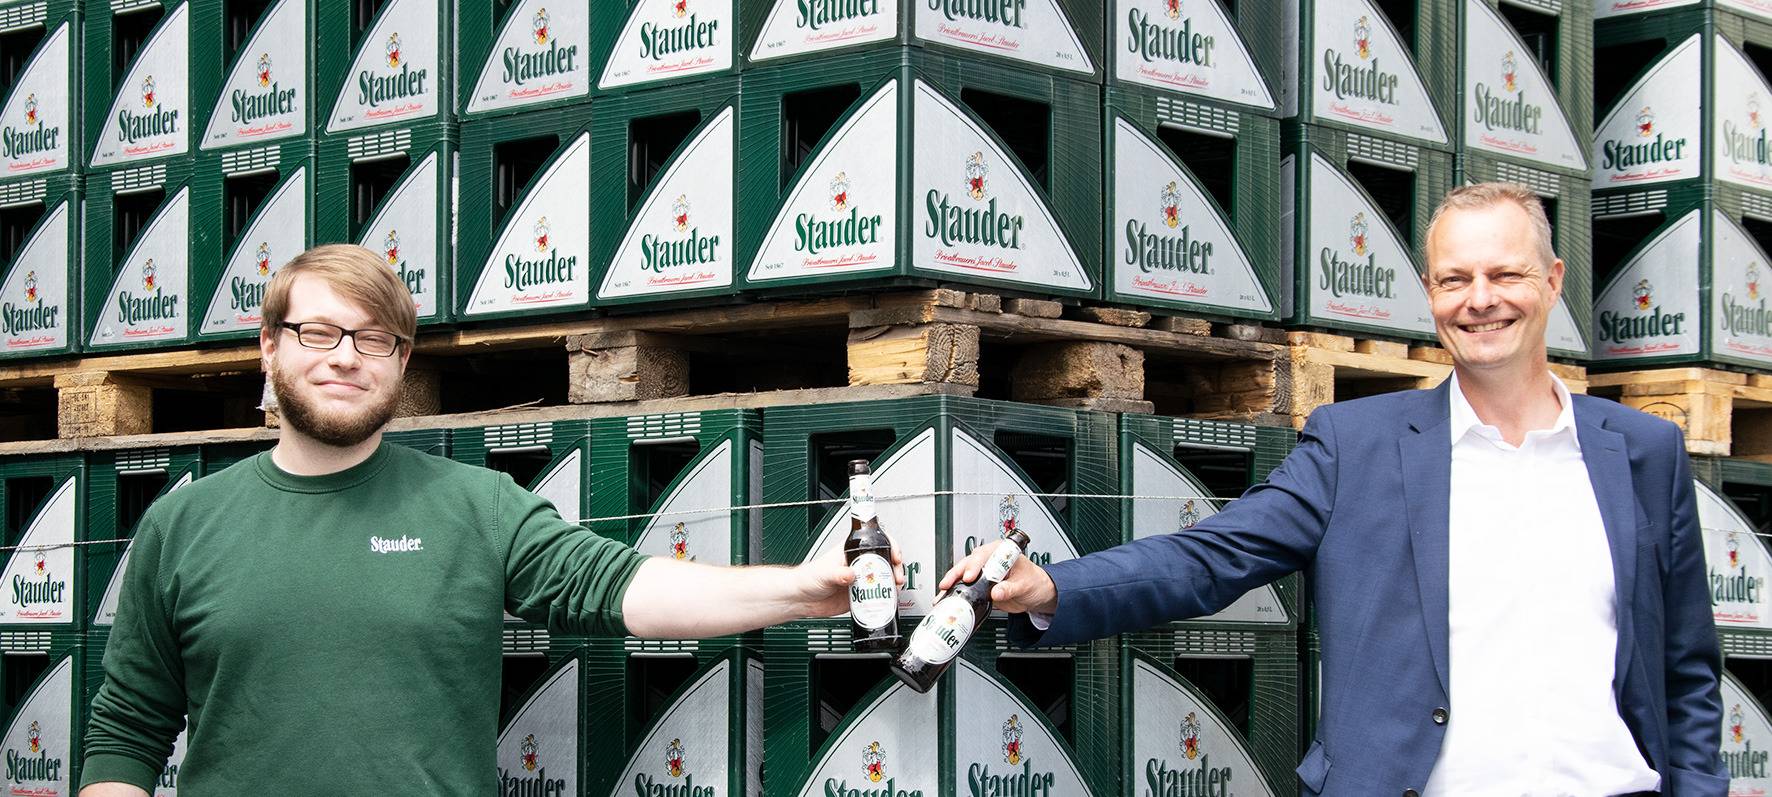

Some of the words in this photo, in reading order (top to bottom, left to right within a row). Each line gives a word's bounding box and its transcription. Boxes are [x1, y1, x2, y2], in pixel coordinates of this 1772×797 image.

[928, 0, 1024, 29] tauder
[640, 14, 718, 60] Stauder
[1128, 8, 1214, 67] Stauder
[503, 38, 577, 85] Stauder
[1323, 49, 1398, 102] Stauder
[232, 82, 296, 124] Stauder
[359, 62, 427, 108] Stauder
[119, 104, 178, 144] Stauder
[1475, 82, 1542, 135] Stauder
[3, 123, 59, 160] Stauder
[1602, 133, 1686, 171] Stauder
[1723, 120, 1772, 166] Staude
[795, 205, 881, 254] Stauder
[925, 189, 1023, 250] Stauder
[641, 228, 719, 273] Stauder
[1126, 219, 1213, 275] Stauder
[505, 248, 576, 291] Stauder
[1320, 247, 1395, 299] Stauder
[119, 287, 178, 326] Stauder
[231, 276, 268, 312] Stau
[1720, 293, 1772, 337] Staude
[3, 301, 58, 337] Stauder
[1599, 305, 1685, 345] Stauder
[12, 573, 65, 608] Stauder
[851, 583, 892, 602] Stauder
[1710, 565, 1763, 607] tauder
[6, 749, 61, 785] Stauder
[1146, 754, 1232, 797] Stauder
